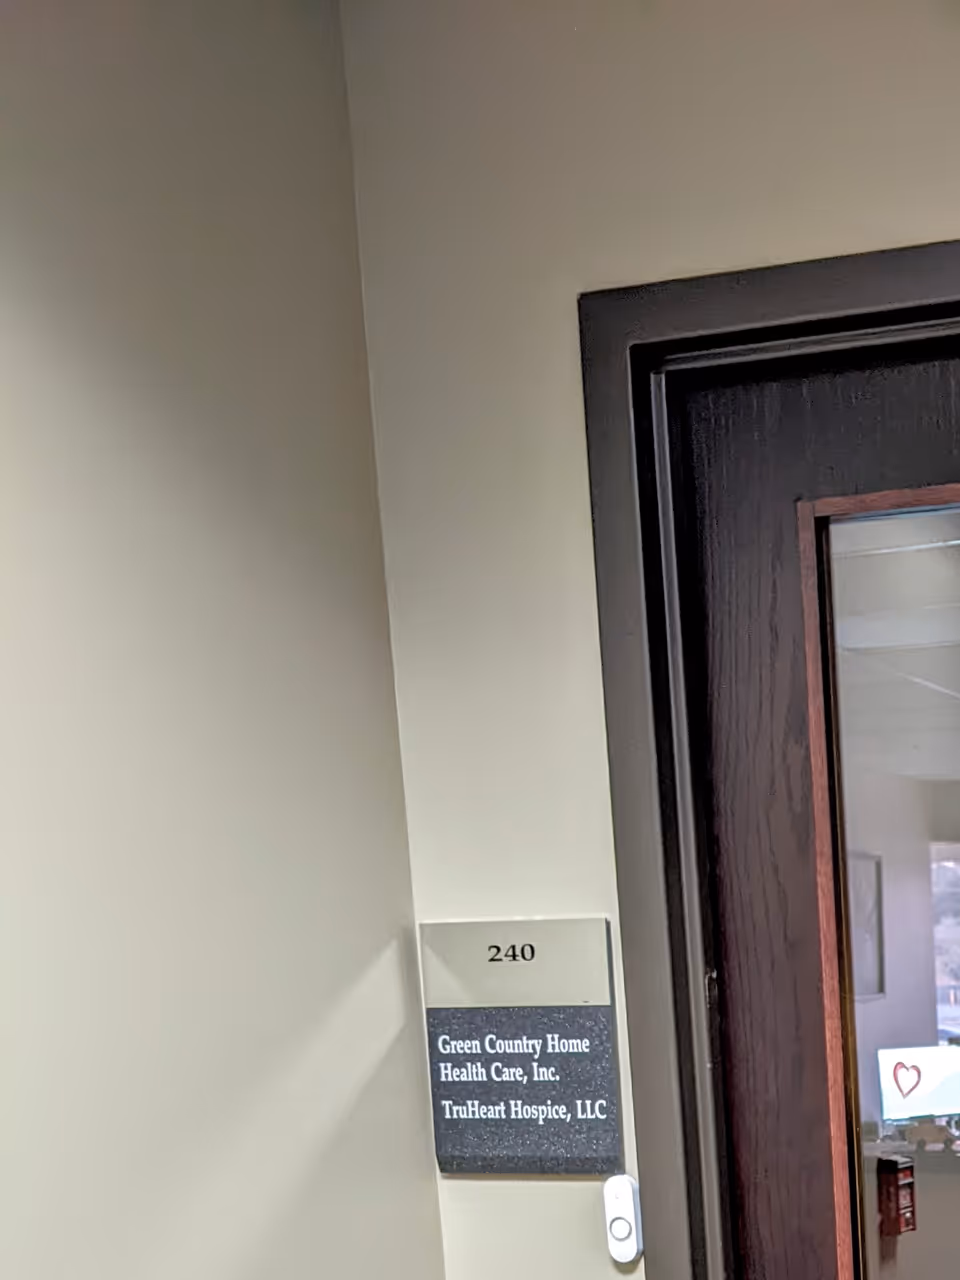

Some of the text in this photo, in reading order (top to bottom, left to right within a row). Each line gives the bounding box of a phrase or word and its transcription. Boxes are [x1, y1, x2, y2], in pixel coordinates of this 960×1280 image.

[487, 943, 536, 963] 240
[437, 1033, 591, 1060] Green Country Home
[438, 1062, 561, 1085] Health Care, Inc.
[441, 1099, 608, 1125] TruHeart Hospice, LLC
